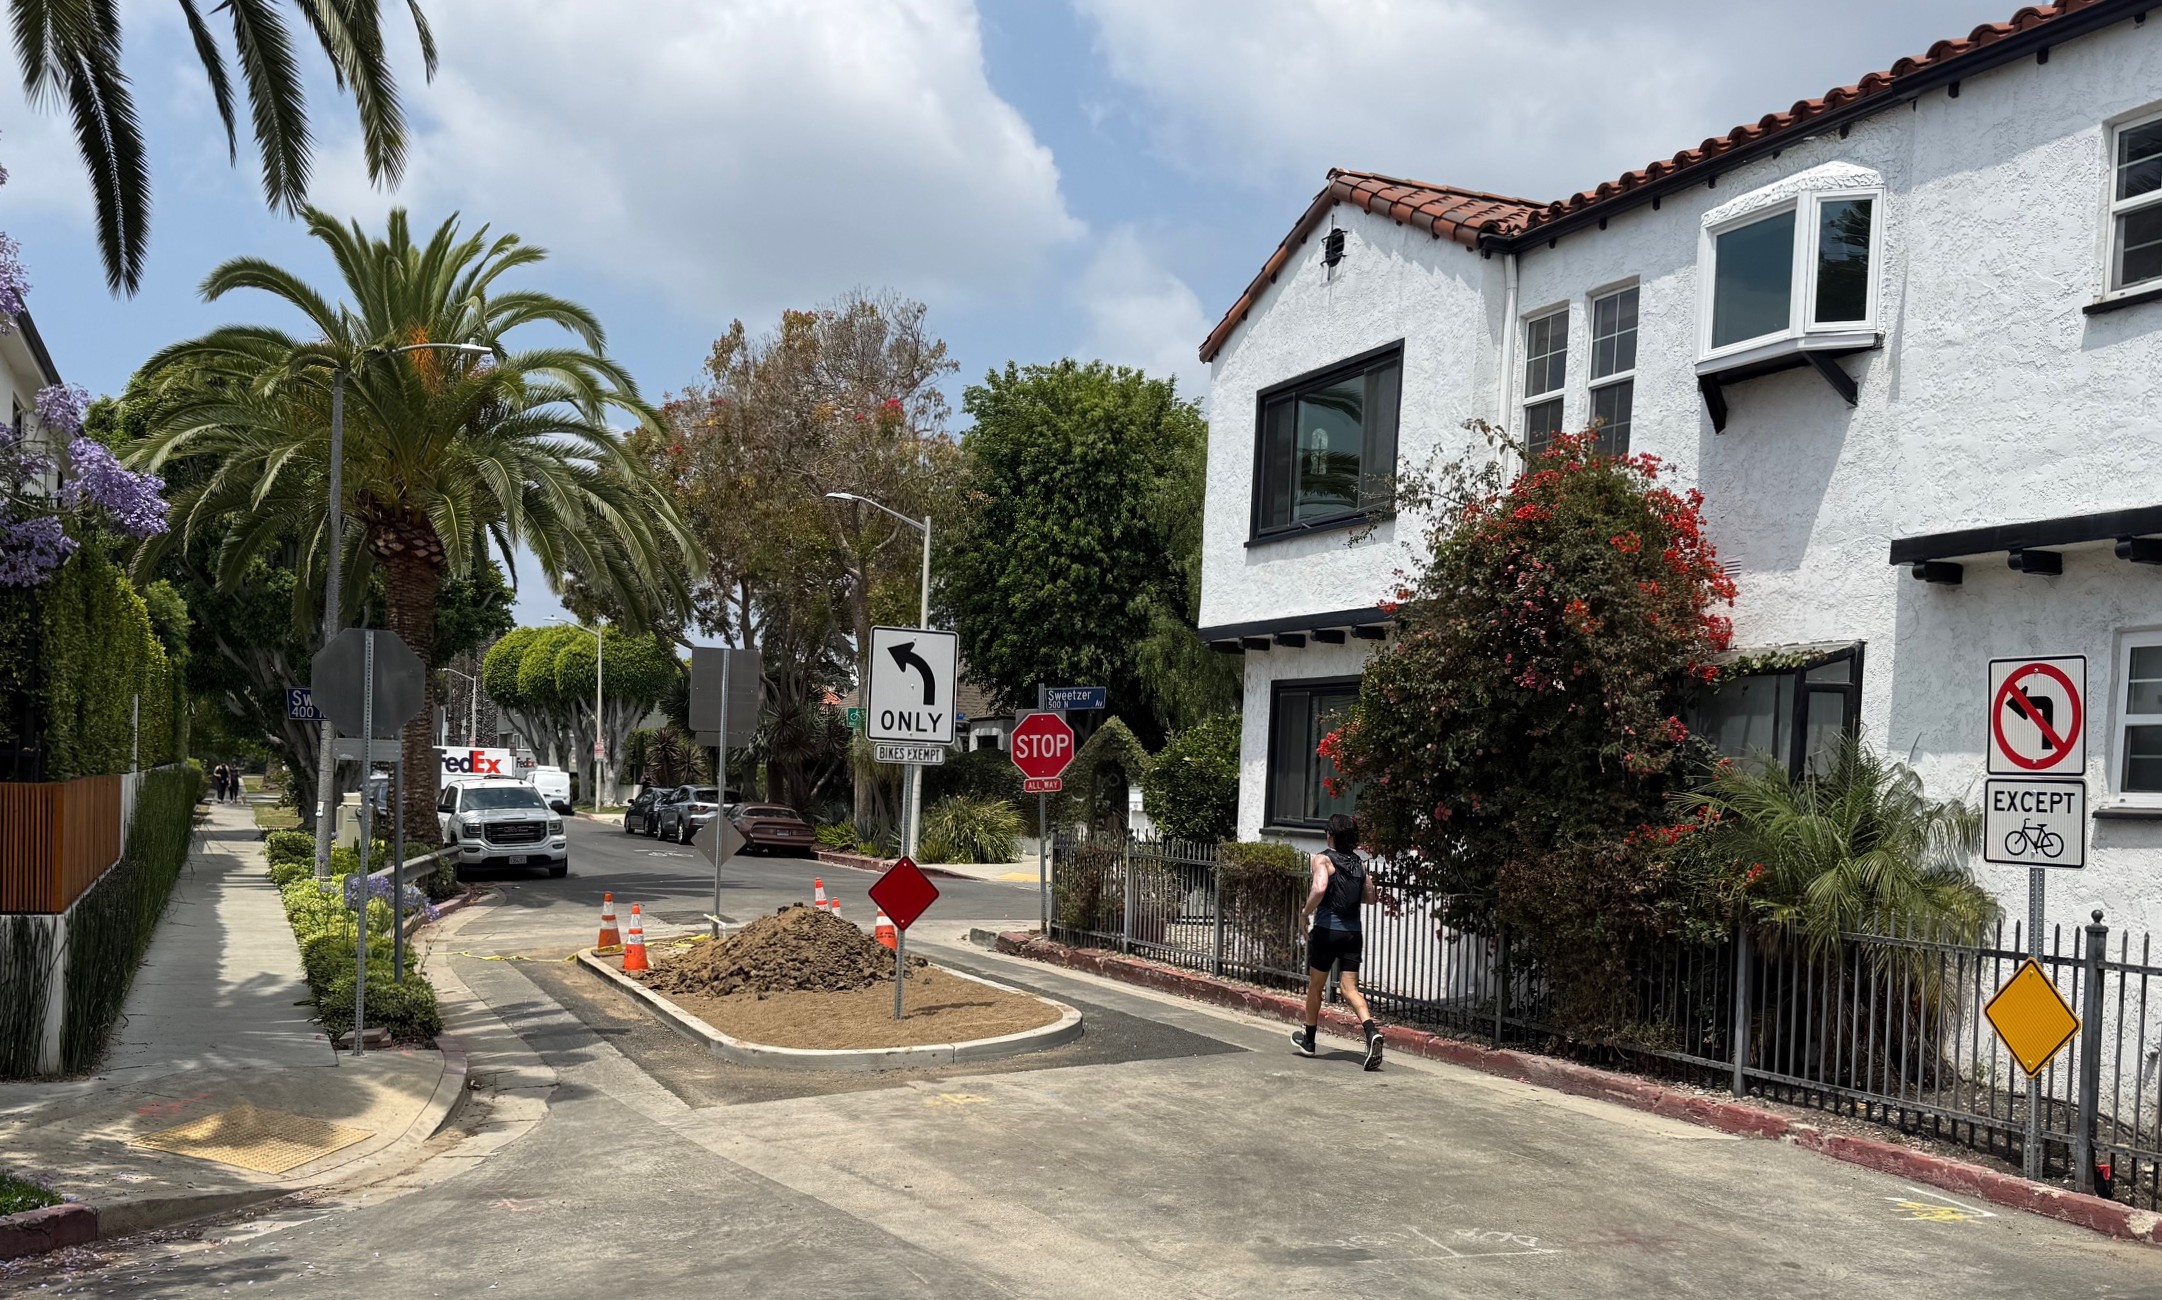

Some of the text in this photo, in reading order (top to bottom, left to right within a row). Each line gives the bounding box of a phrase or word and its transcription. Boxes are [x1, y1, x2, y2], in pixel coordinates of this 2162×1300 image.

[1048, 690, 1092, 700] Sweetzer
[1048, 699, 1103, 709] 500 N Av
[291, 706, 314, 718] 400
[881, 709, 942, 733] ONLY
[1016, 734, 1069, 759] STOP
[879, 747, 940, 761] BIKES EXEMPT
[1028, 780, 1058, 789] ALL WAY
[1994, 790, 2075, 814] EXCEPT
